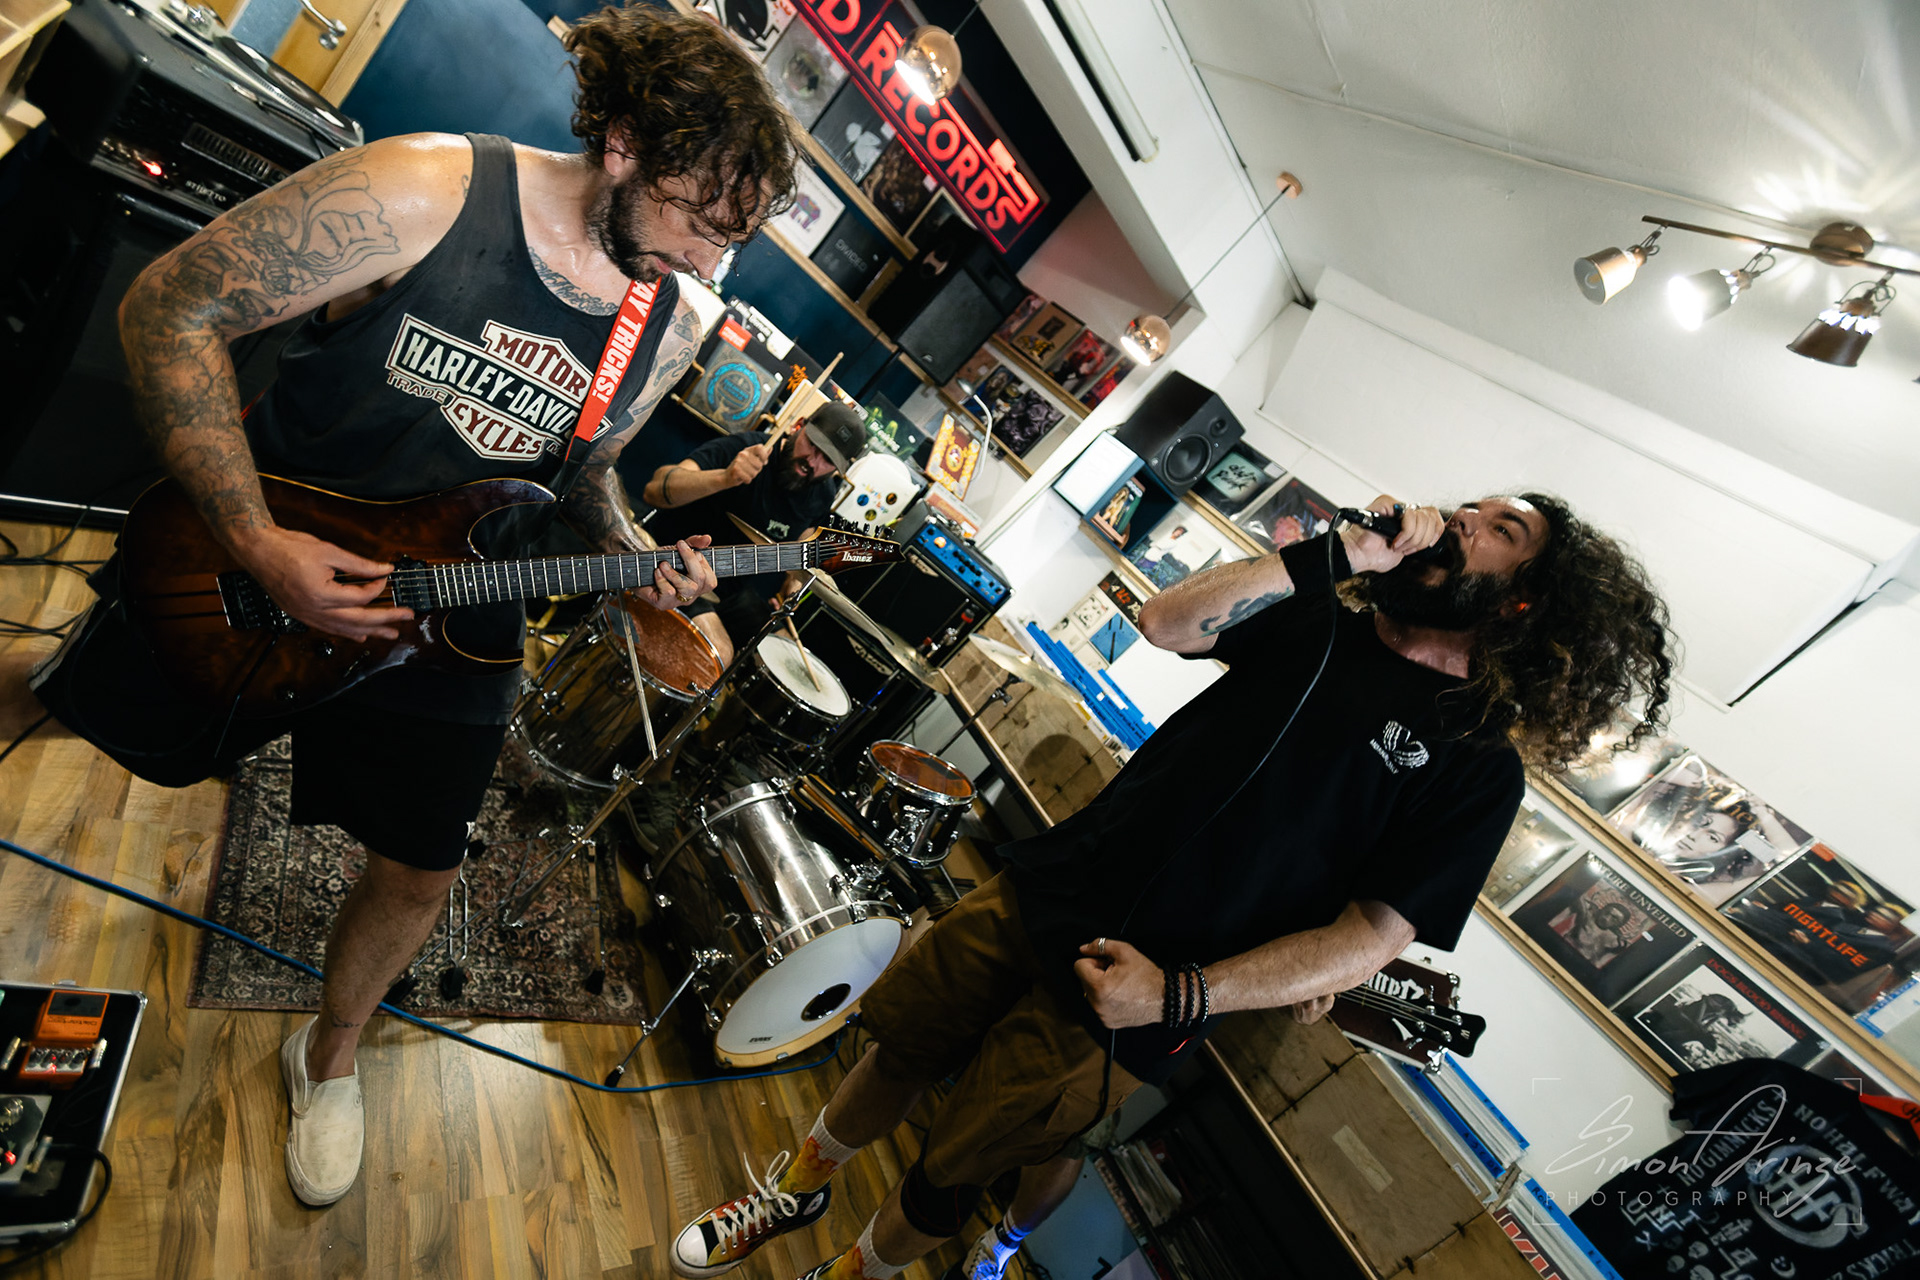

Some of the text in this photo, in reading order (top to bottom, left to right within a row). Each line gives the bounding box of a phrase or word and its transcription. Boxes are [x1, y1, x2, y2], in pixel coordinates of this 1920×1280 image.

[858, 29, 1012, 231] RECORDS
[387, 372, 448, 404] TRADE
[401, 332, 606, 438] HARLEY-DAVID
[493, 332, 587, 398] MOTOR
[591, 313, 644, 404] TRICKS!
[453, 403, 541, 455] CYCLES
[841, 550, 872, 563] Ibanez
[1629, 889, 1687, 940] UNVEILED
[1784, 903, 1869, 967] NIGHTLIFE
[1706, 957, 1737, 985] DOGS
[1700, 1100, 1778, 1170] GIMMICKS
